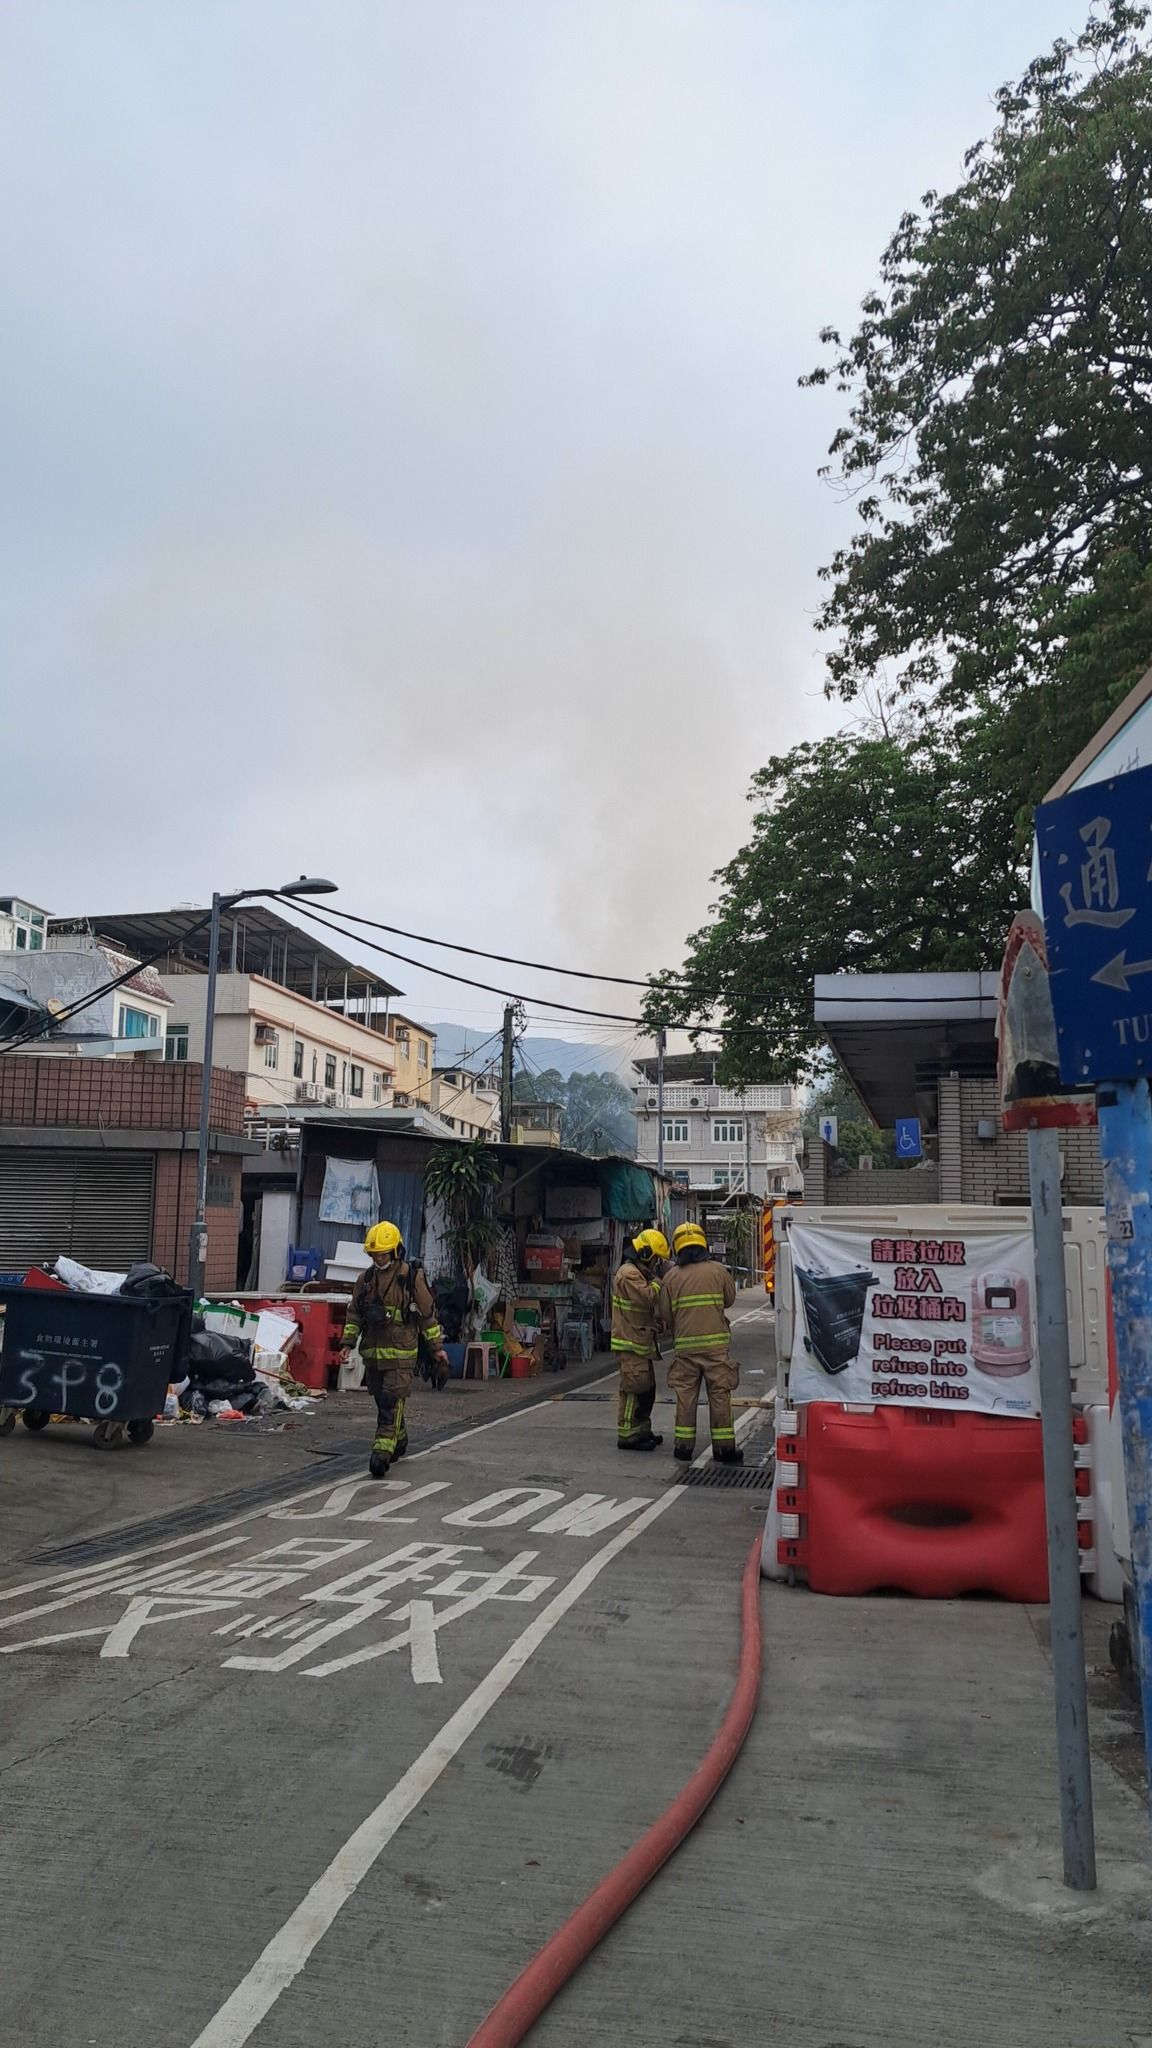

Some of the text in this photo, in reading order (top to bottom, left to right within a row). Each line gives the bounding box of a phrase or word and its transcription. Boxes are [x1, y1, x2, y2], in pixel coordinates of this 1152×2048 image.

[1059, 816, 1152, 929] 通
[1112, 1012, 1152, 1046] TU
[871, 1239, 966, 1265] 請將垃圾
[895, 1267, 943, 1292] 放入
[873, 1333, 930, 1351] Please
[934, 1338, 967, 1356] put
[872, 1356, 968, 1377] refuse into
[871, 1379, 969, 1399] refuse bins
[268, 1479, 655, 1538] SLOW
[0, 1536, 558, 1684] 慢駛
